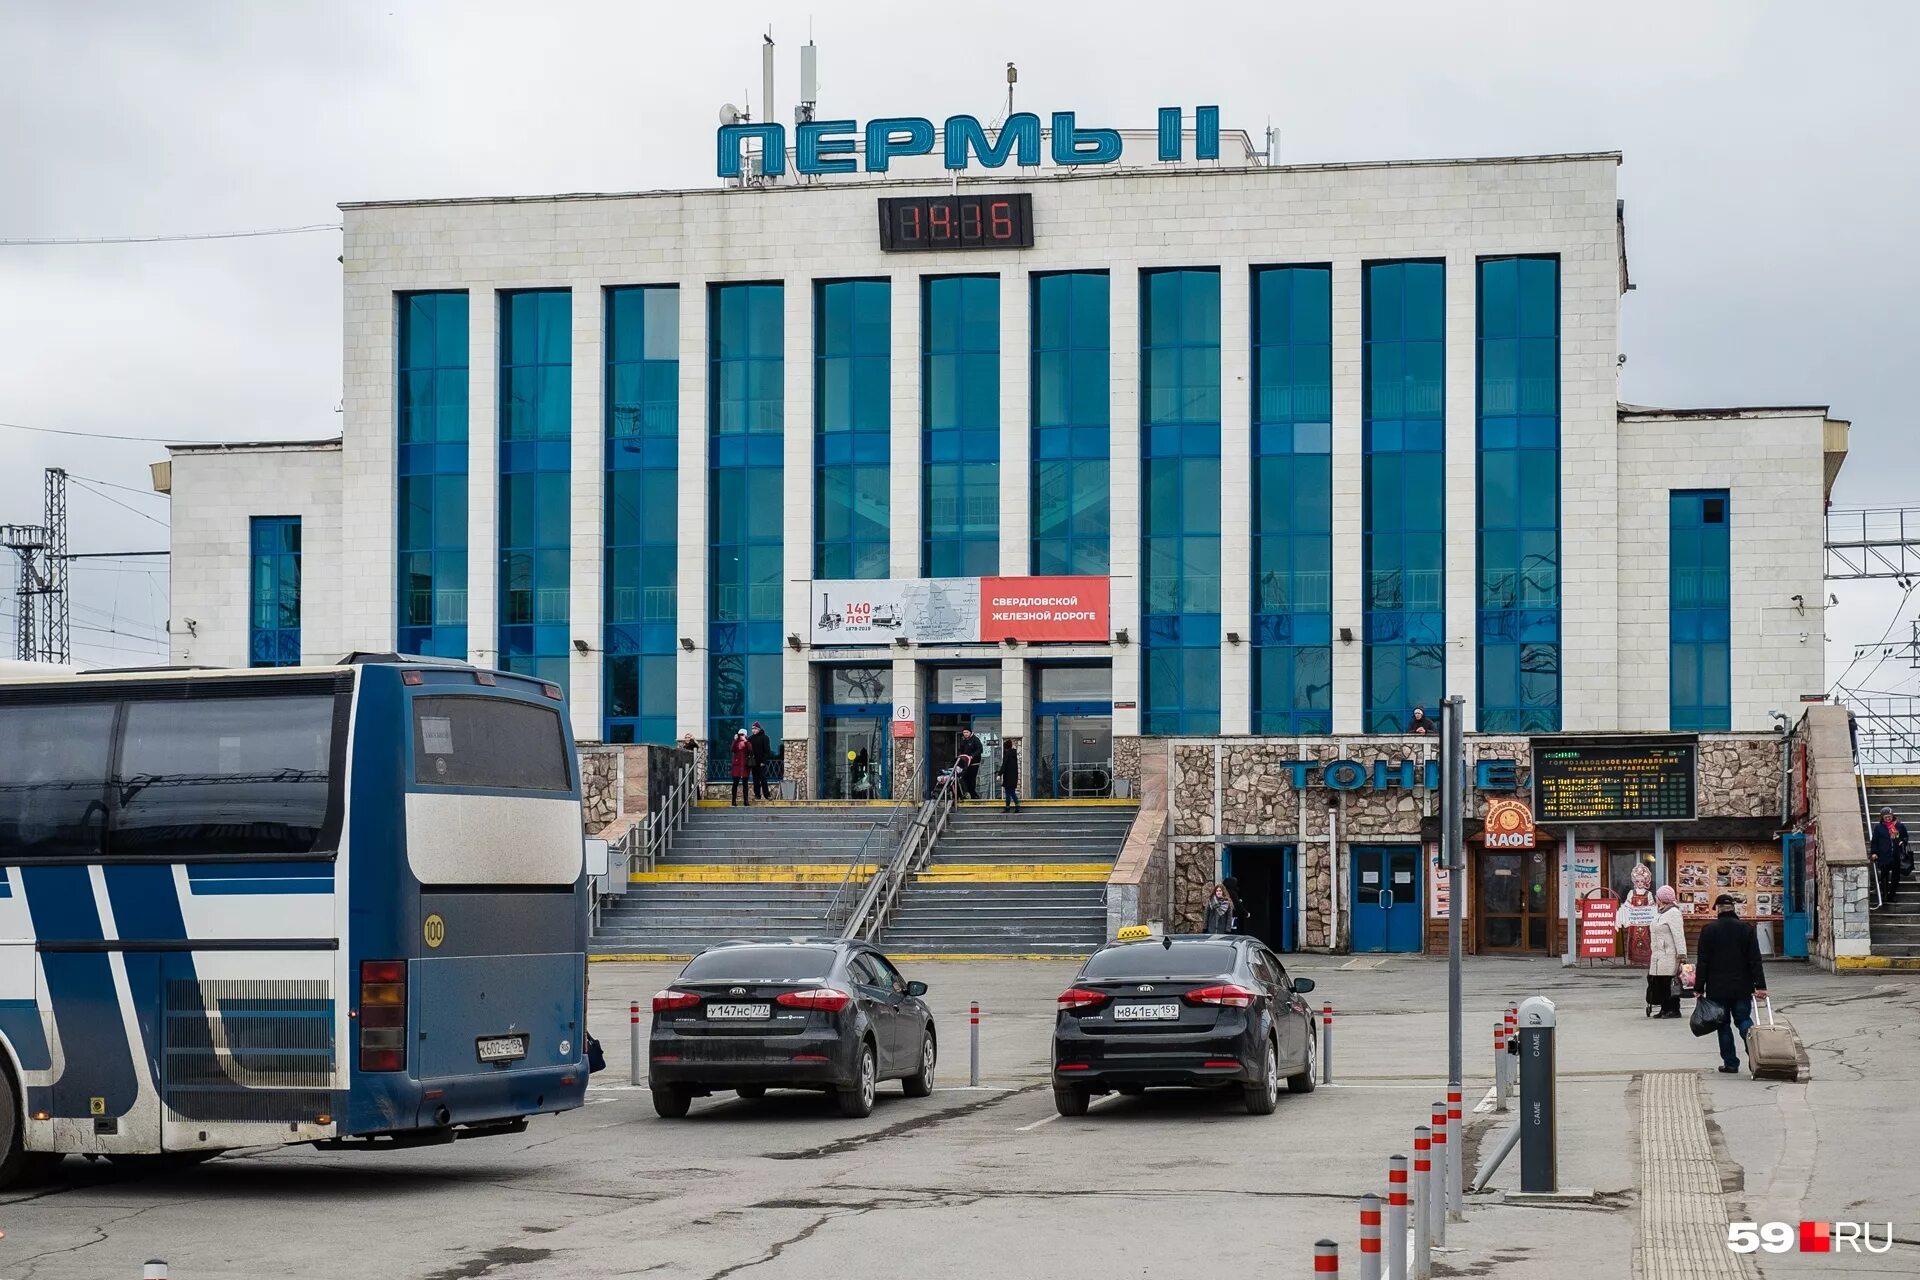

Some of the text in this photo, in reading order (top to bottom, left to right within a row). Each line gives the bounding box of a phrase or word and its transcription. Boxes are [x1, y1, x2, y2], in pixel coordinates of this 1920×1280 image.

[717, 105, 1220, 178] ПЕРМЬ II
[912, 202, 1012, 241] 14:16
[992, 595, 1078, 607] СВЕРДЛОВСКОЙ
[846, 603, 870, 614] 140
[846, 615, 870, 624] лет
[992, 610, 1096, 621] ЖЕЛЕЗНОЙ ДОРОГЕ
[1622, 757, 1680, 765] НАПРАВЛЕНИЕ
[1486, 832, 1533, 846] КАФЕ
[426, 922, 442, 941] 100
[710, 1005, 767, 1016] У147НС 777
[1117, 1005, 1176, 1017] М841ЕХ 159
[561, 1043, 569, 1051] RUS
[1533, 1101, 1541, 1125] CAME
